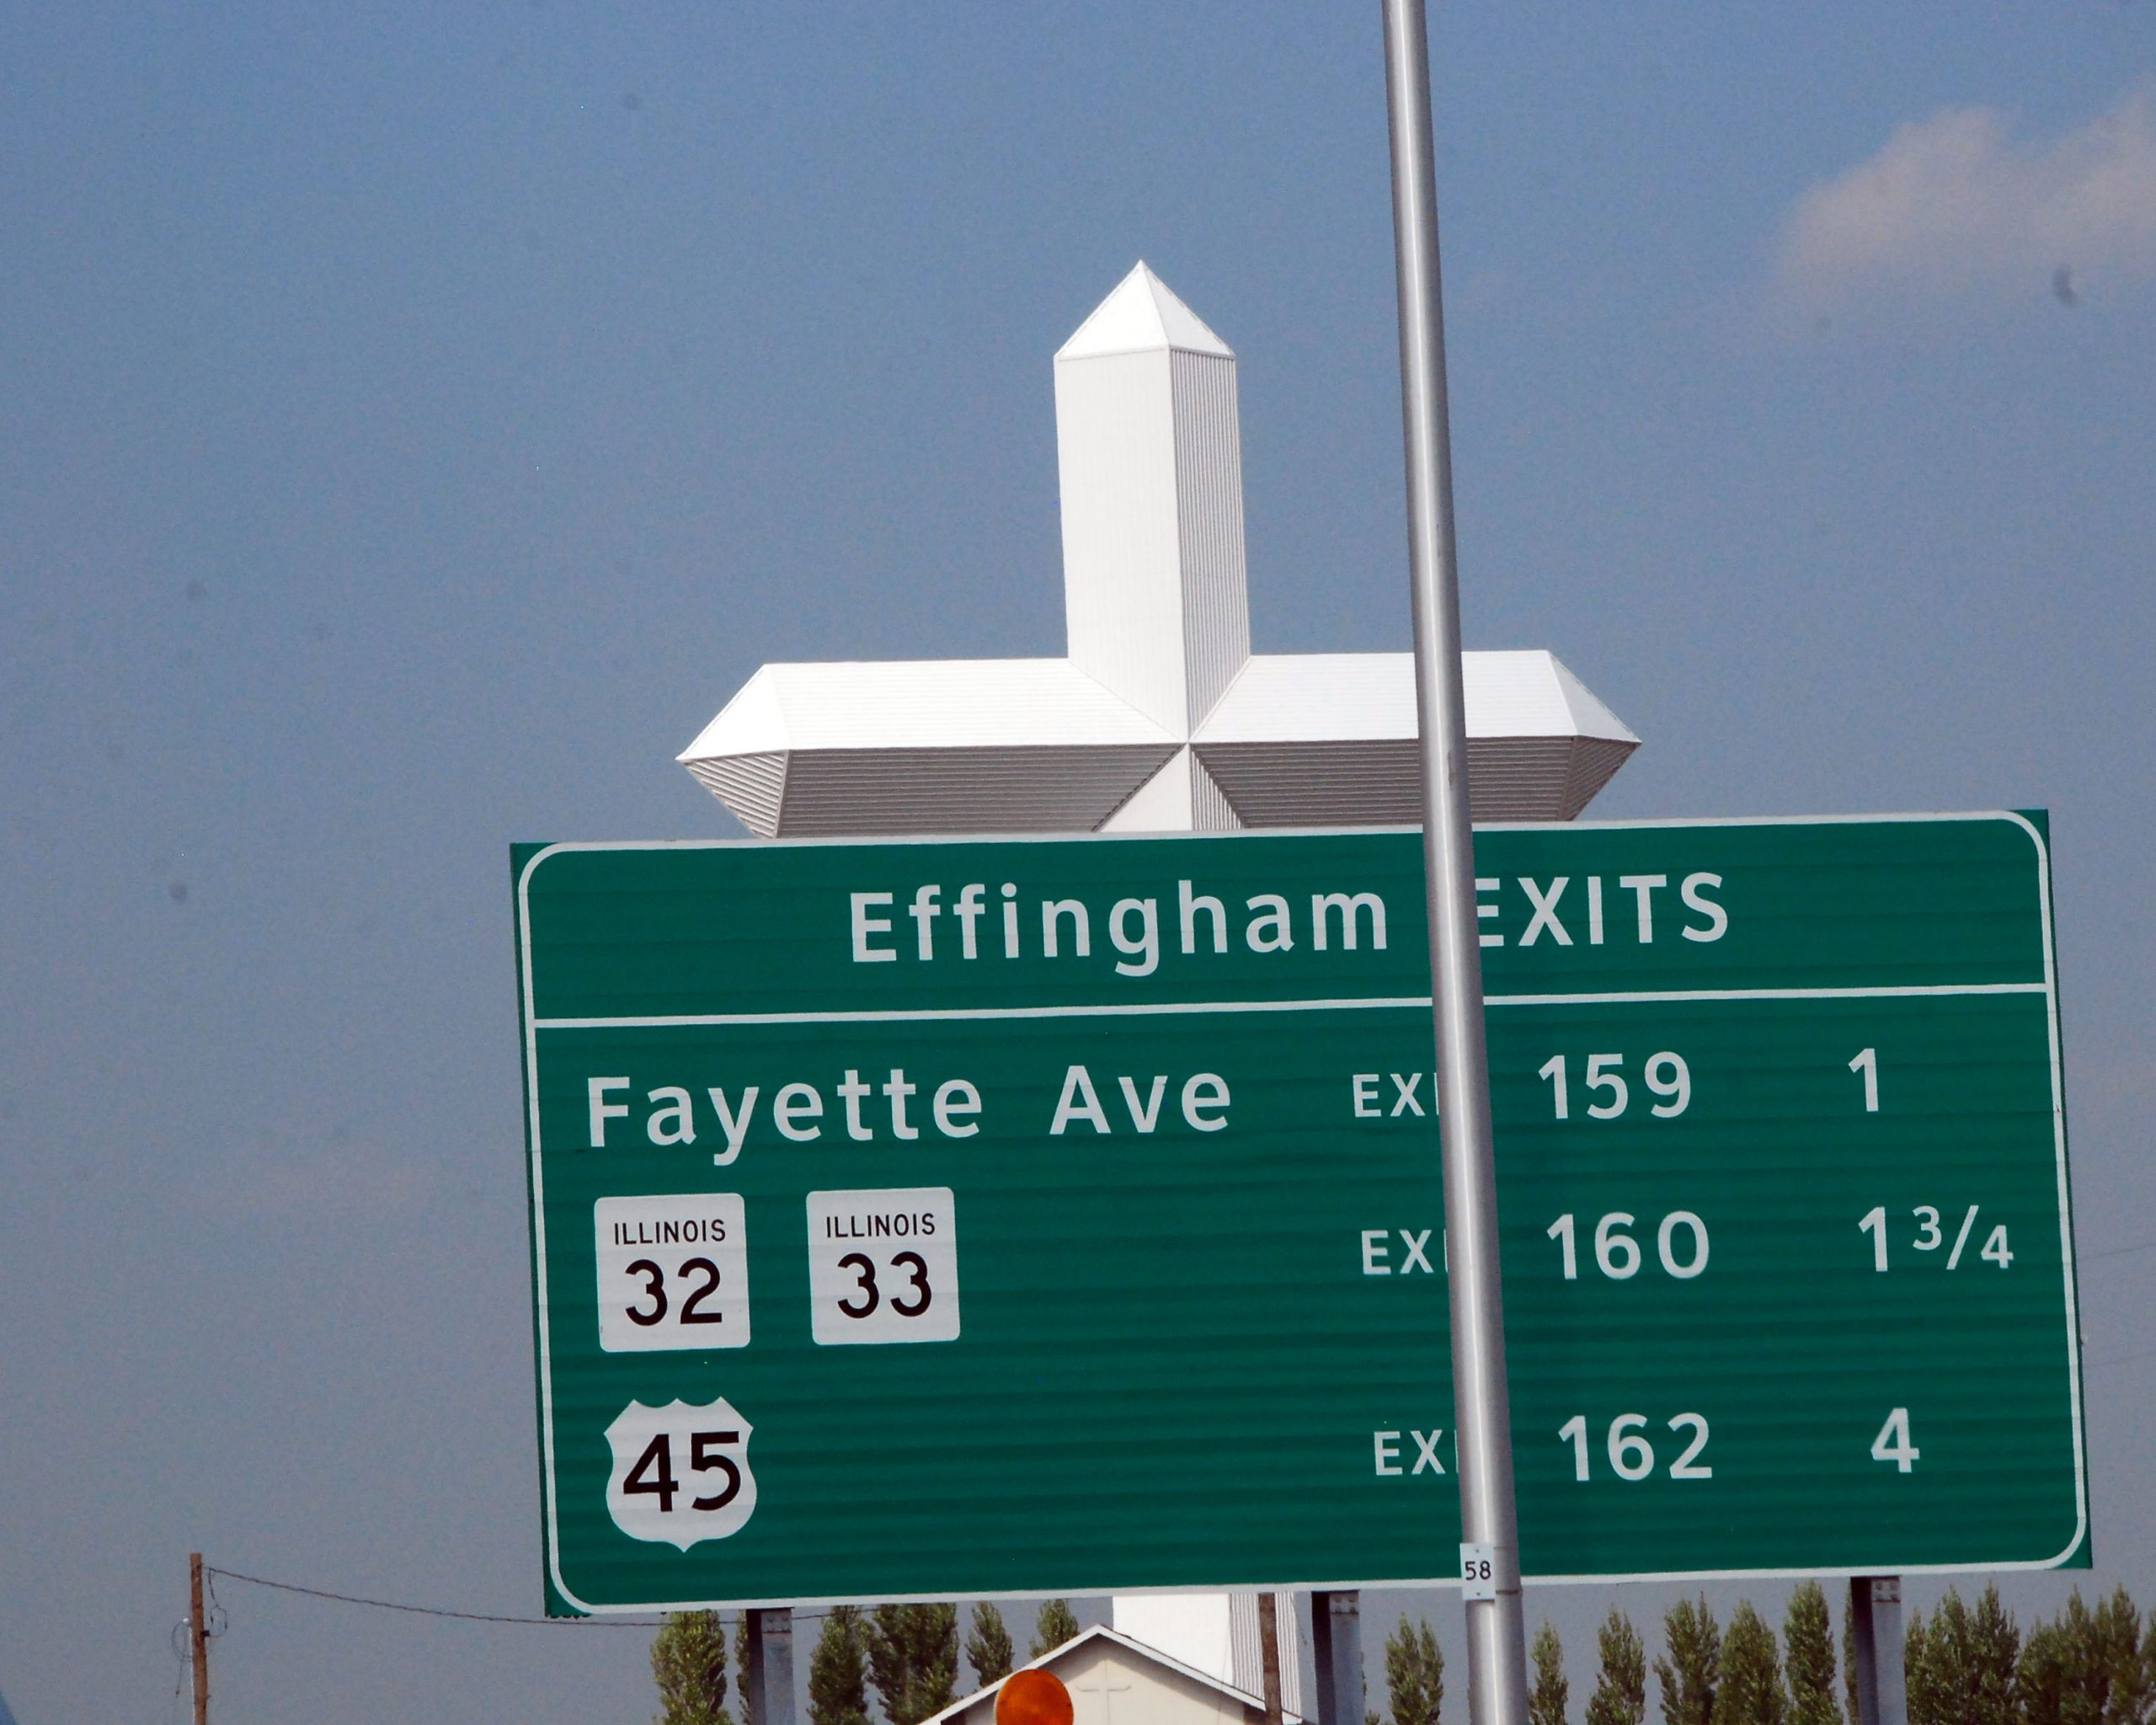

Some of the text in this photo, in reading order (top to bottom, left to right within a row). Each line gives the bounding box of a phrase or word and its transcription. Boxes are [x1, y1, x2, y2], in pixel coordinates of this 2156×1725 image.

[851, 879, 1387, 977] Effingham
[588, 1048, 1879, 1166] Fayette Ave EX 159 1
[614, 1219, 727, 1245] ILLINOIS
[825, 1213, 936, 1238] ILLINOIS
[1362, 1230, 1448, 1275] EX
[1547, 1211, 1709, 1279] 160
[1858, 1206, 1888, 1272] 1
[625, 1257, 723, 1326] 32
[837, 1251, 932, 1319] 33
[622, 1430, 741, 1513] 45
[1374, 1407, 1919, 1481] EX 162 4
[1465, 1560, 1492, 1581] 58
